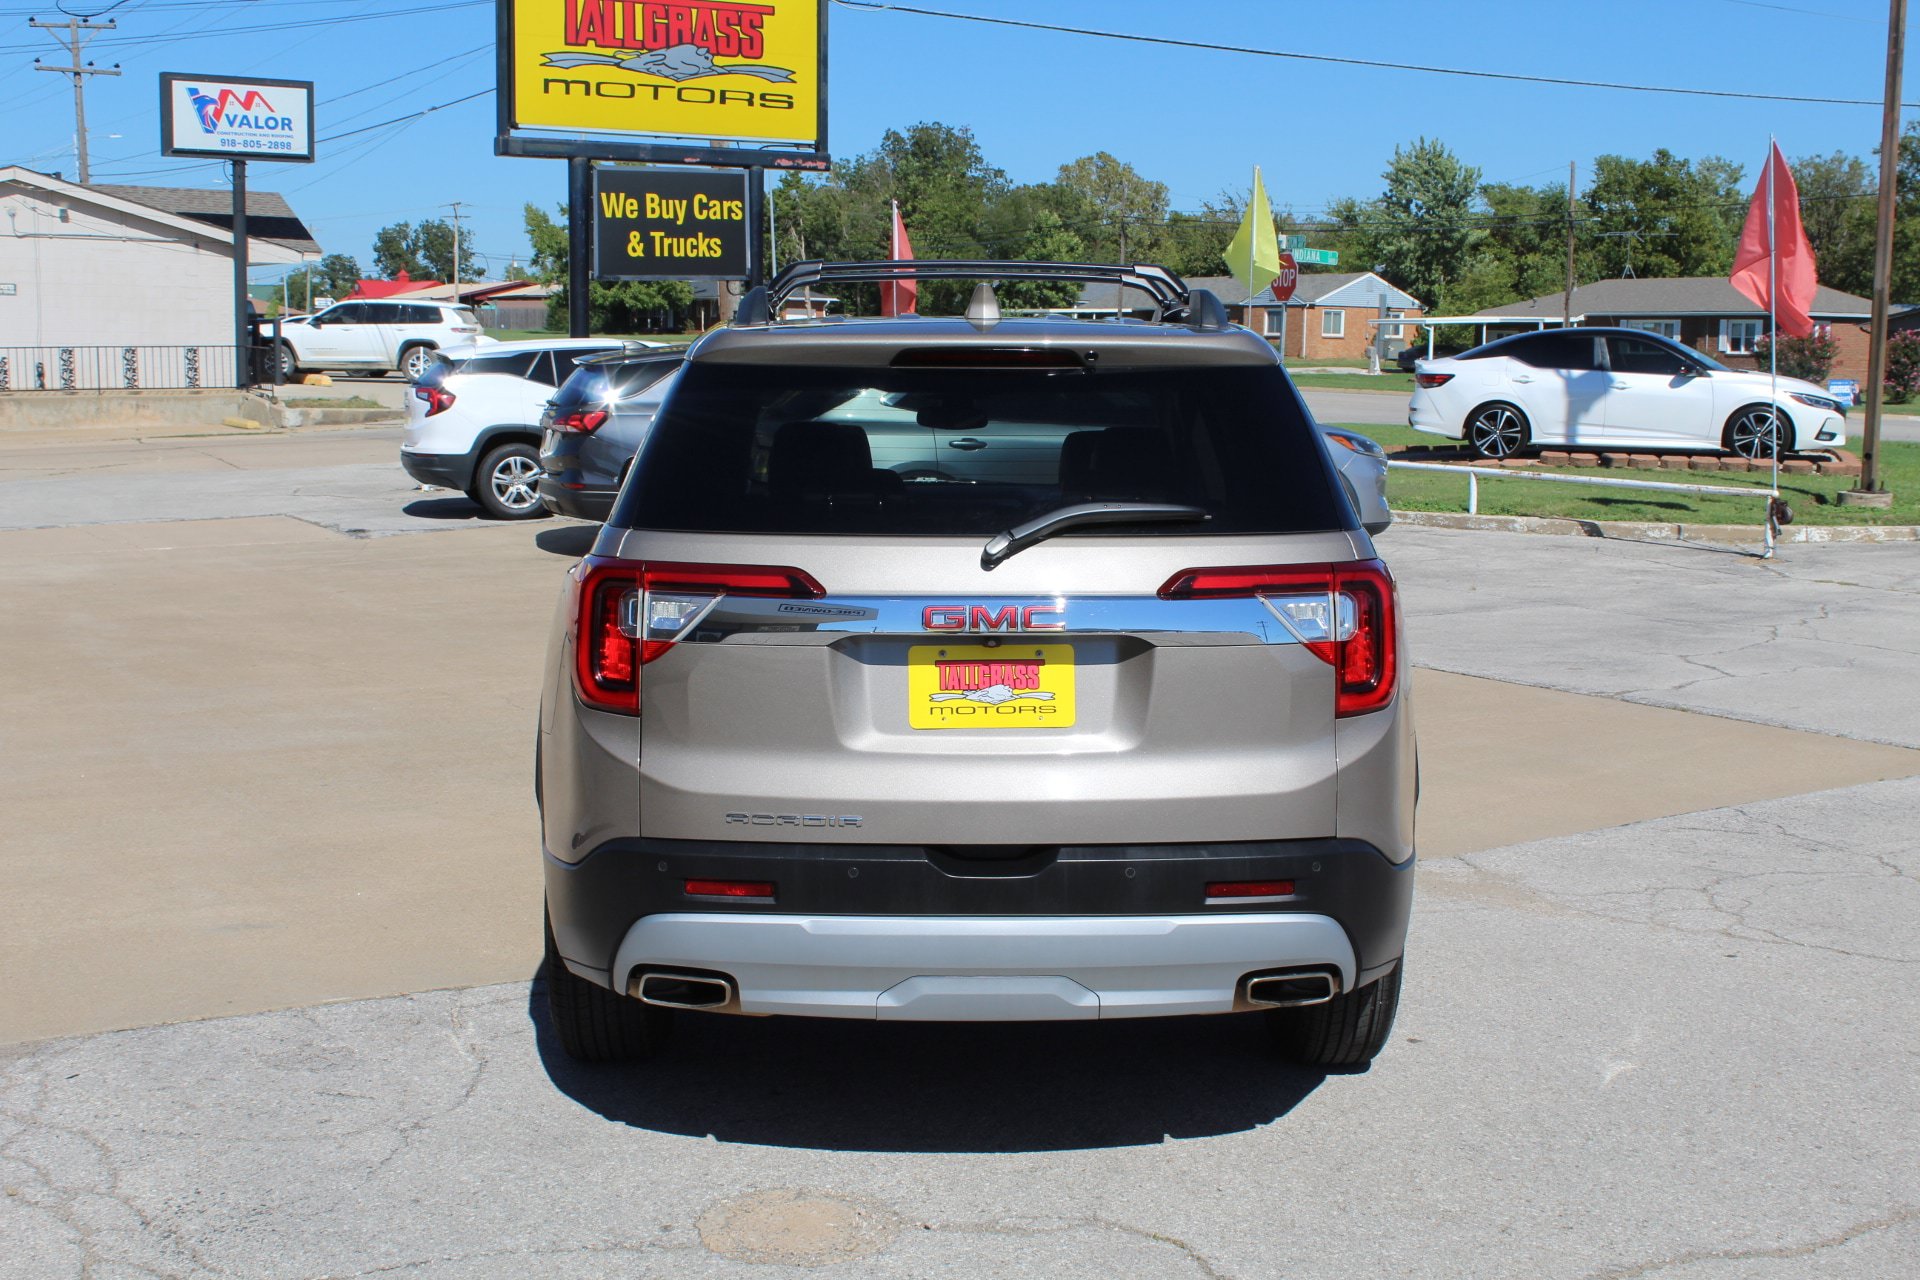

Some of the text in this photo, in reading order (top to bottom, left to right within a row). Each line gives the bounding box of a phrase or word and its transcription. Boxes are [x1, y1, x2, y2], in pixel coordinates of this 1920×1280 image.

[565, 0, 774, 59] TALLGRASS
[543, 78, 794, 110] MOTORS
[224, 113, 293, 131] VALOR
[220, 138, 292, 150] 918-805-2898
[600, 192, 743, 225] We Buy Cars
[627, 230, 722, 258] & Trucks
[1293, 248, 1320, 261] INDIANA
[922, 605, 1066, 632] GMC
[935, 659, 1045, 691] TALLGRASS
[929, 705, 1057, 716] MOTORS
[725, 811, 863, 828] ACADIA
